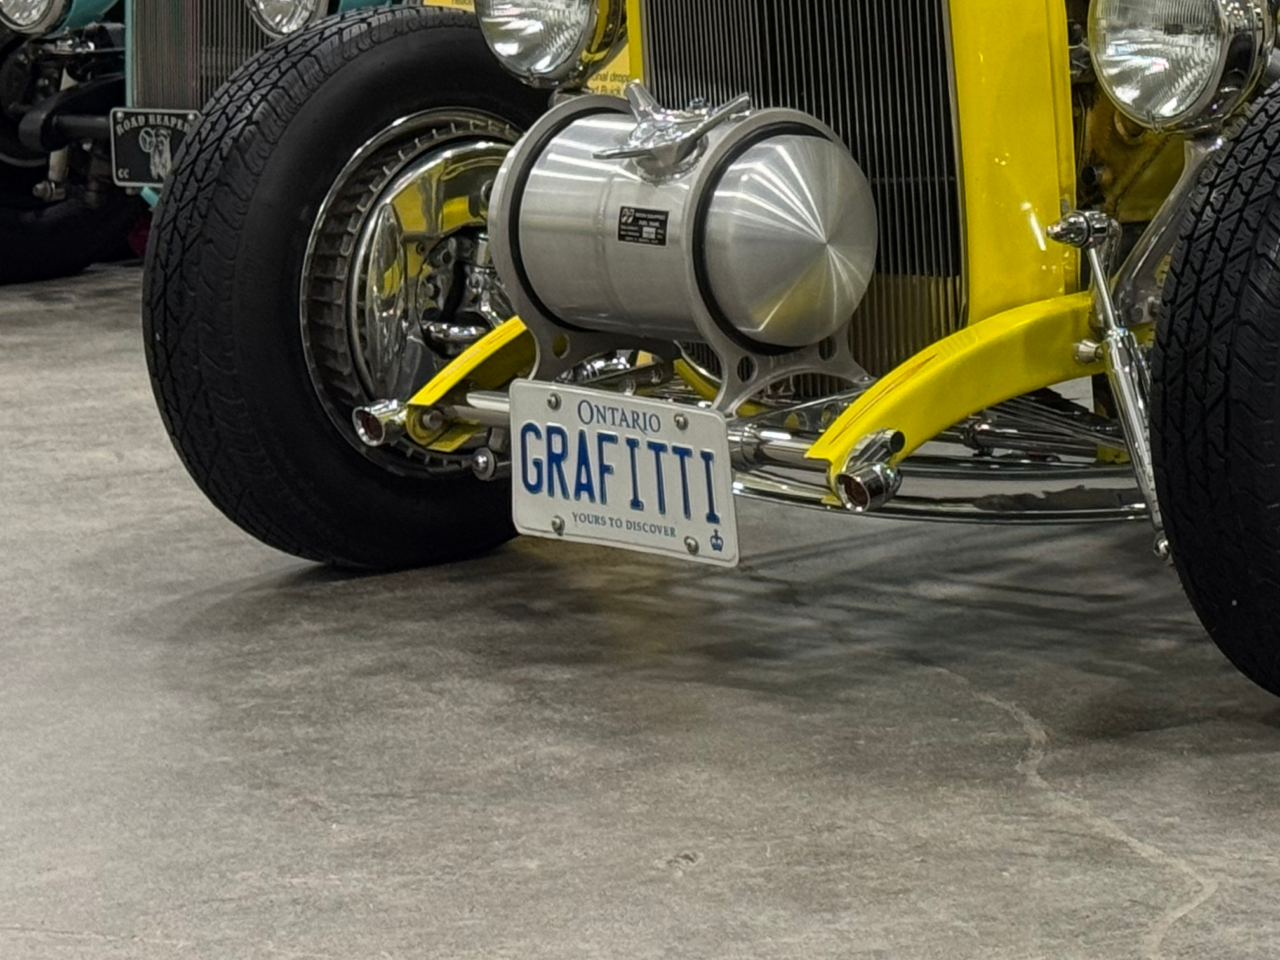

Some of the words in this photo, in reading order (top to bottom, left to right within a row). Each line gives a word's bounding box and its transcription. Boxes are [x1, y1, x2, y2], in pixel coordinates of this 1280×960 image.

[116, 115, 146, 136] ROAD
[118, 168, 130, 179] CC
[577, 399, 661, 436] ONTARIO
[520, 422, 721, 525] GRAFITTI
[572, 512, 607, 527] YOURS
[609, 518, 623, 529] TO
[625, 520, 677, 538] DISCOVER
